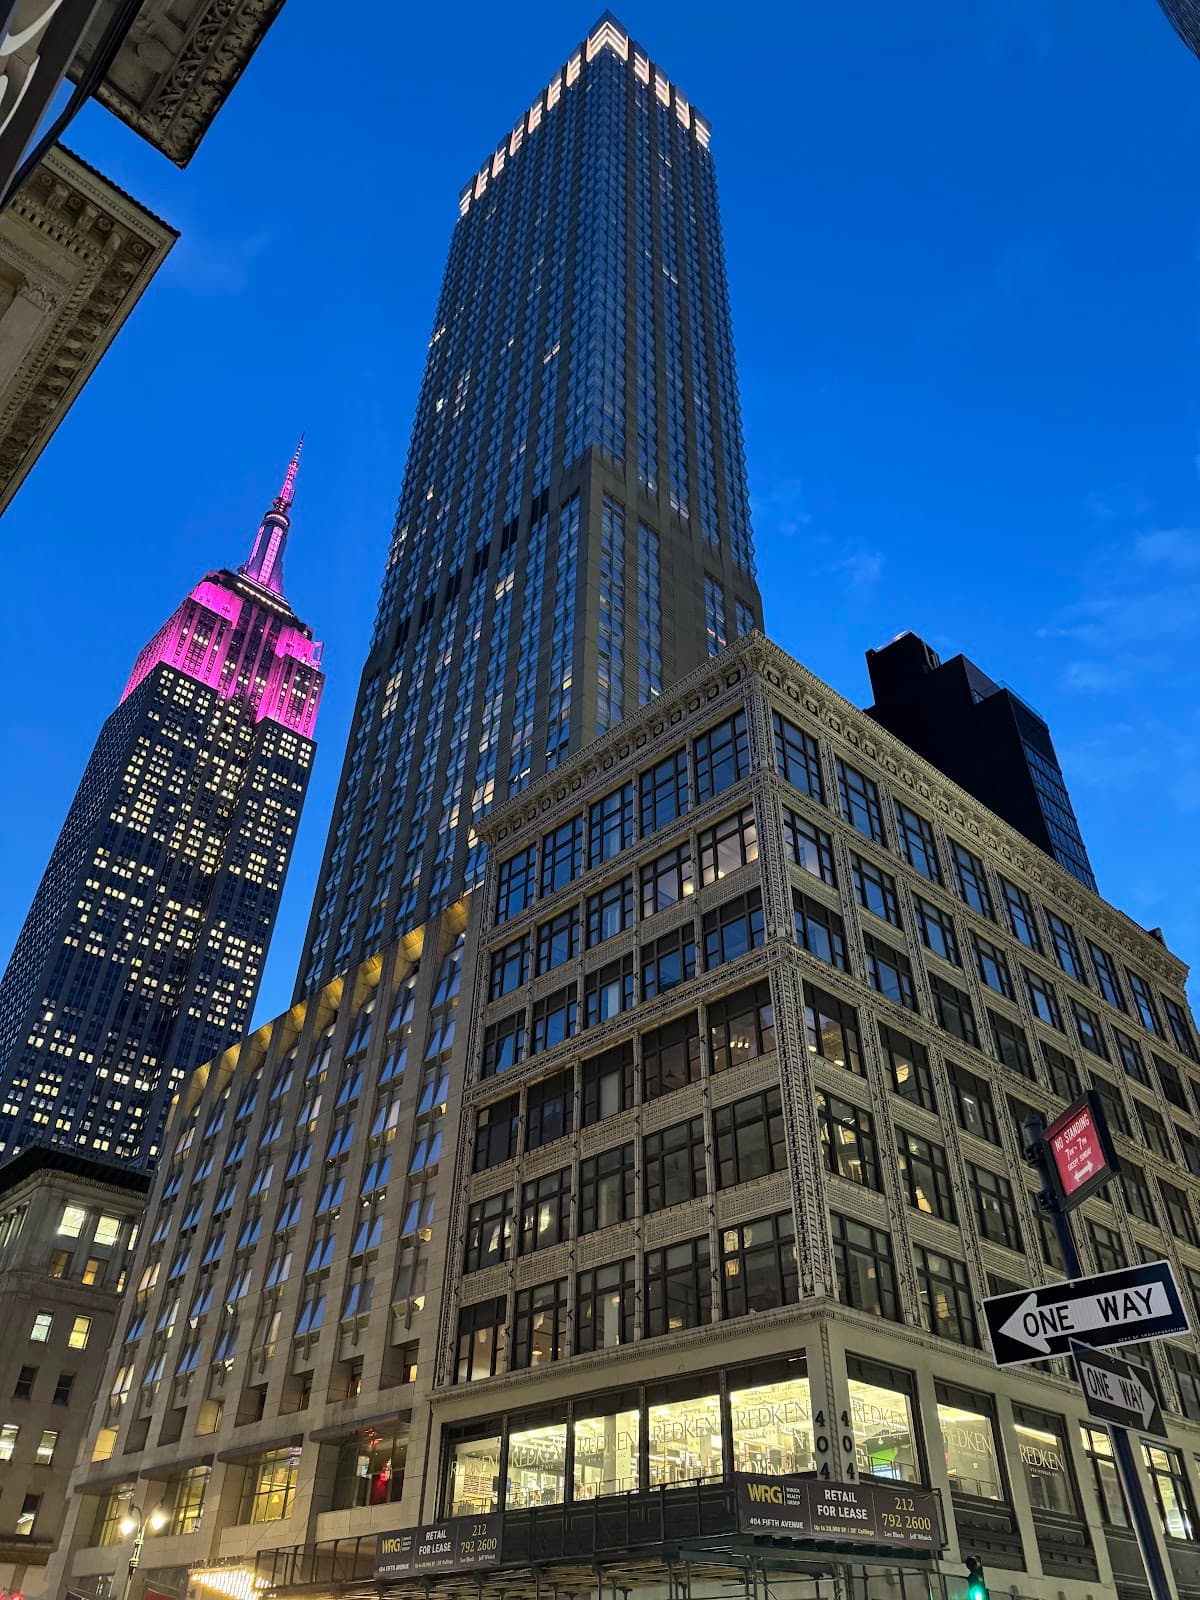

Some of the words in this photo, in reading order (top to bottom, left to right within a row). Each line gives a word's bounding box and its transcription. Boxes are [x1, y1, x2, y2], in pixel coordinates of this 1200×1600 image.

[1054, 1136, 1064, 1152] NO
[1064, 1114, 1090, 1143] STANDING
[1023, 1305, 1074, 1337] ONE
[1096, 1287, 1153, 1322] WAY
[1087, 1368, 1113, 1400] ONE
[1119, 1379, 1144, 1410] WAY
[736, 1400, 810, 1430] REDKEN
[852, 1400, 906, 1430] REDKEN
[652, 1415, 717, 1443] REDKEN
[579, 1429, 637, 1454] REDEN
[814, 1410, 830, 1480] 404
[841, 1410, 855, 1480] 404
[941, 1427, 993, 1455] REDKEN
[1018, 1443, 1065, 1473] REDKEN
[747, 1483, 783, 1505] WRG
[825, 1489, 857, 1503] RETAIL
[894, 1497, 915, 1511] 212
[750, 1517, 761, 1526] 404
[762, 1518, 780, 1528] FIFTH
[781, 1520, 804, 1529] AVENUE
[817, 1504, 836, 1517] FOR
[839, 1506, 868, 1520] LEASE
[882, 1513, 903, 1527] 792
[904, 1515, 931, 1530] 2600
[425, 1529, 447, 1541] RETAIL
[471, 1523, 487, 1536] 212
[382, 1538, 401, 1554] WRG
[418, 1545, 431, 1555] FOR
[432, 1541, 452, 1554] LEASE
[461, 1541, 475, 1553] 792
[477, 1537, 497, 1552] 2600
